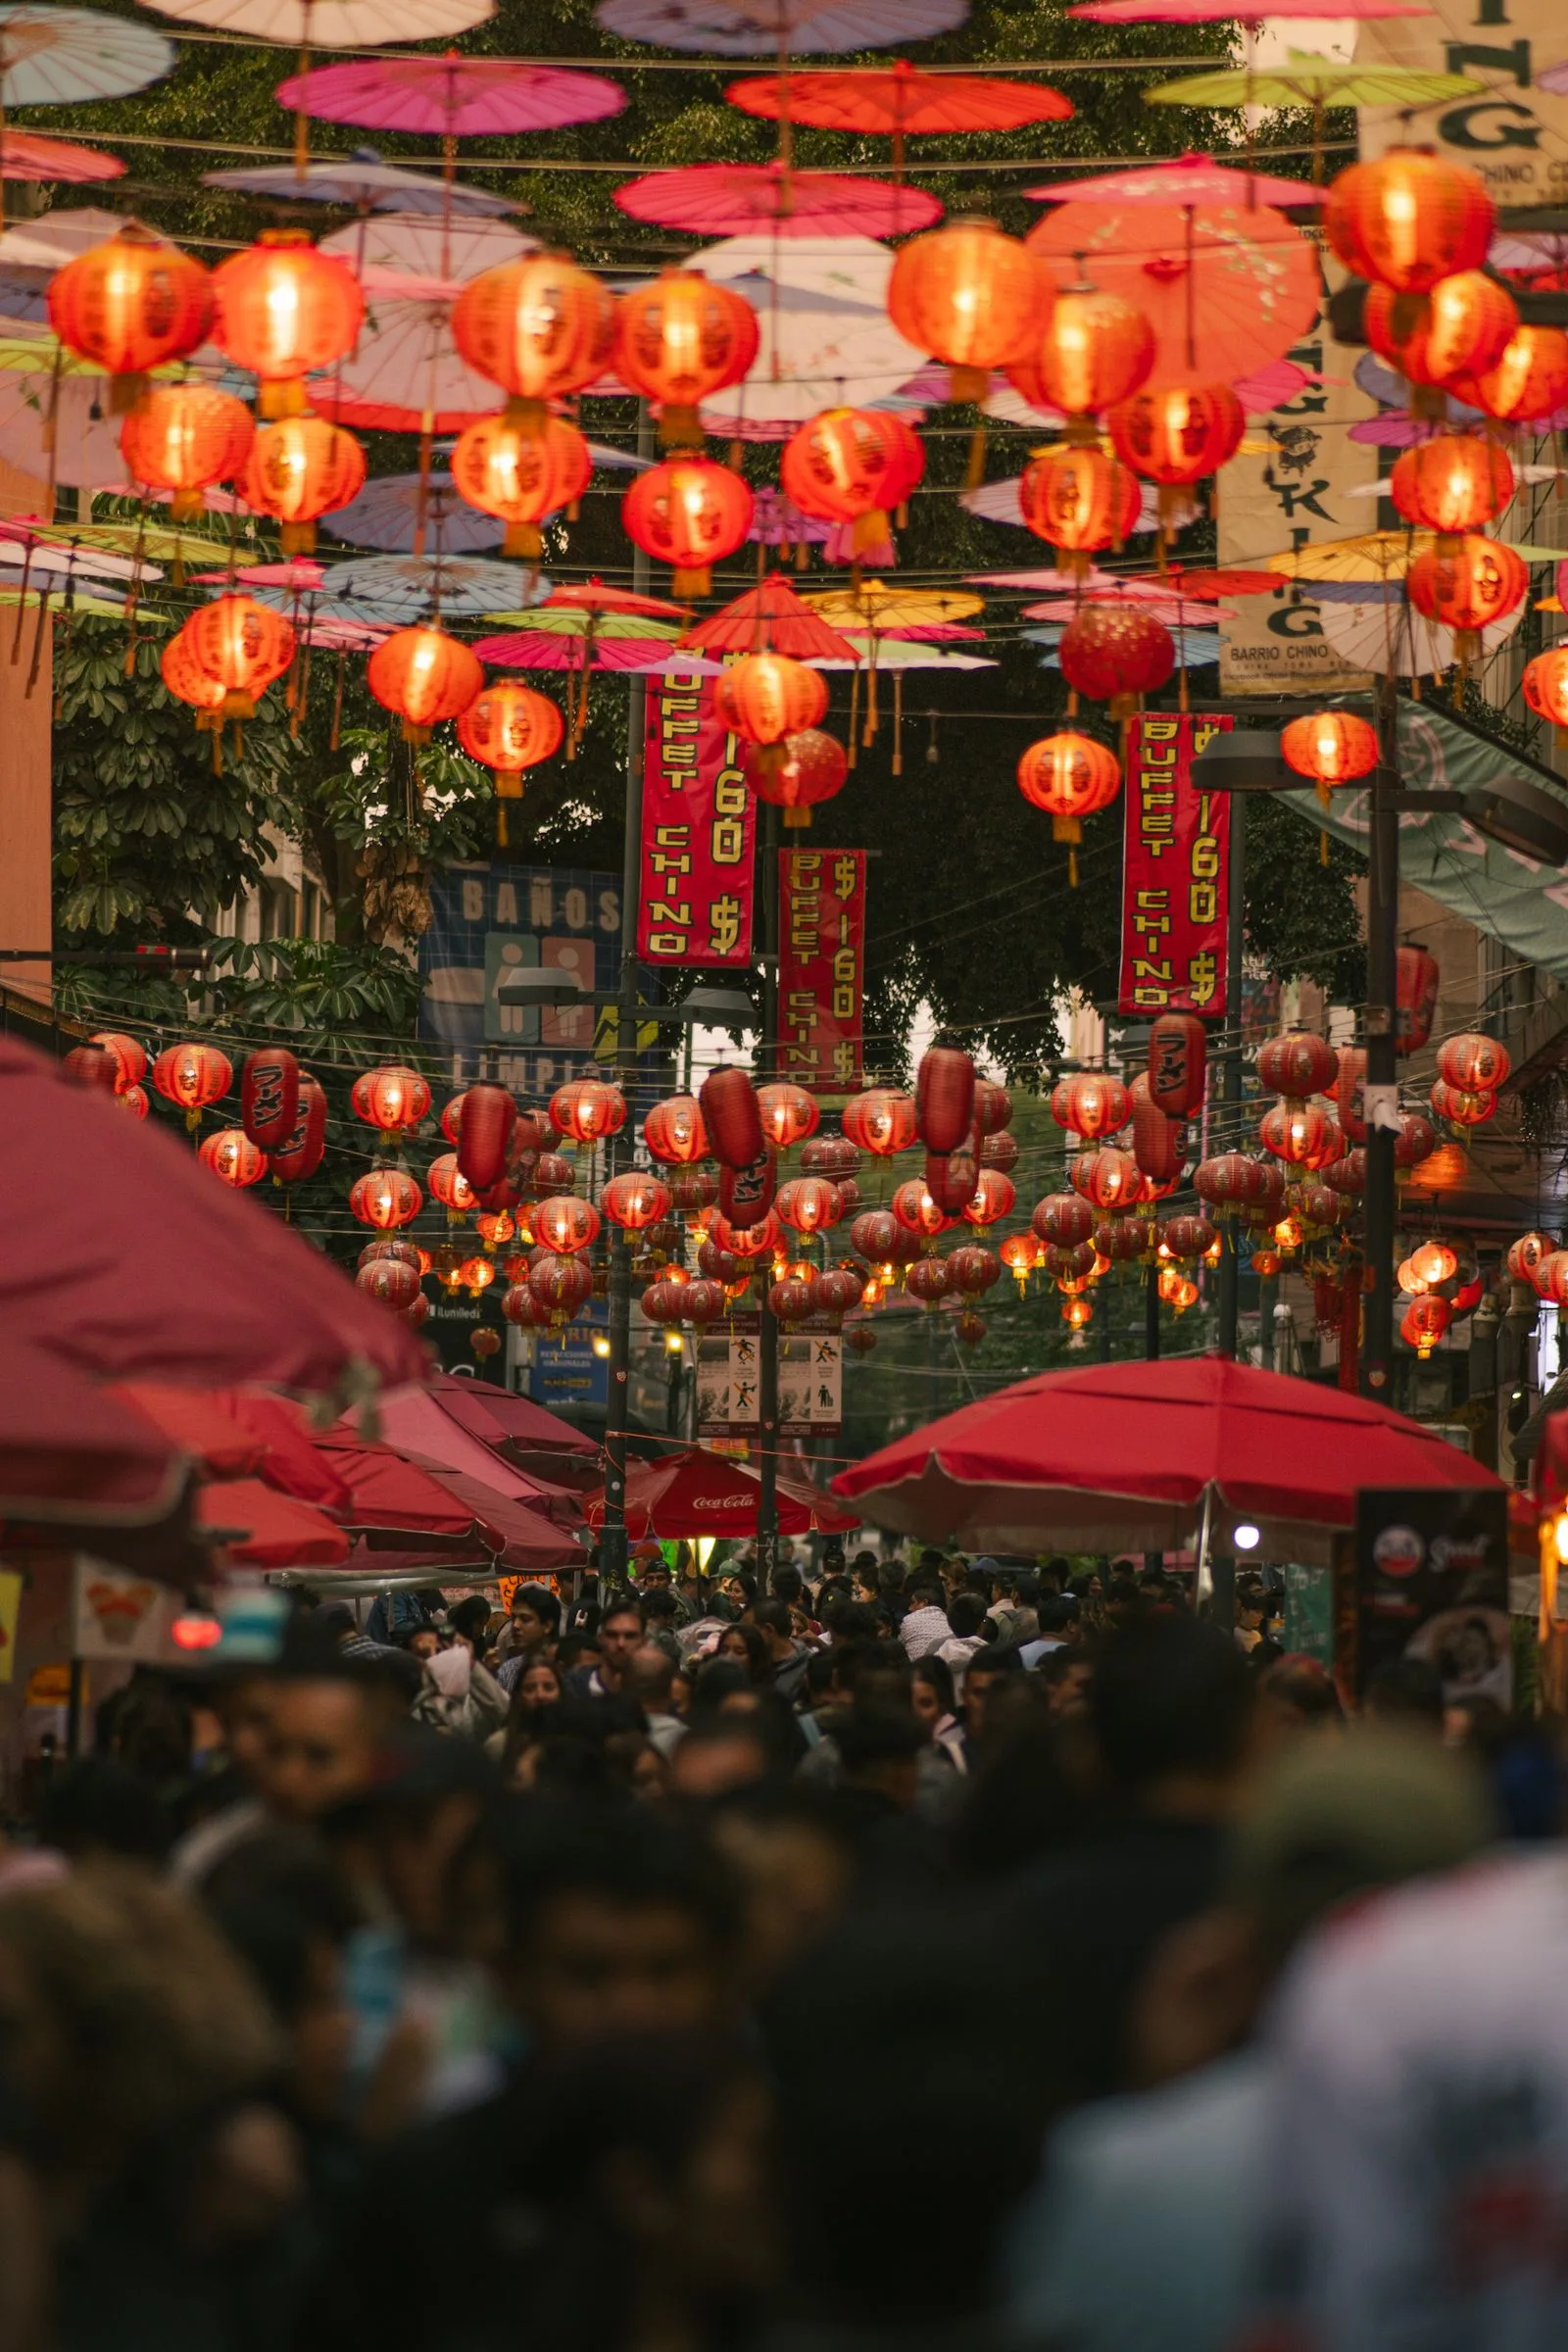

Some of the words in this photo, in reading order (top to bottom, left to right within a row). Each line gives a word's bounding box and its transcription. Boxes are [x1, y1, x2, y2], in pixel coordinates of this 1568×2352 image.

[1230, 647, 1279, 662] BARRIO
[1286, 645, 1328, 659] CHINO
[1139, 720, 1179, 857] BUFFET
[462, 875, 620, 932] BAÑOS
[647, 825, 693, 955] CHINO
[790, 854, 823, 966] BUFFET
[1131, 889, 1173, 1006] CHINO
[453, 1053, 600, 1094] LIMPI
[786, 991, 819, 1085] CHINO
[252, 1065, 284, 1129] ラーメン
[692, 1494, 757, 1510] Coca-Cola
